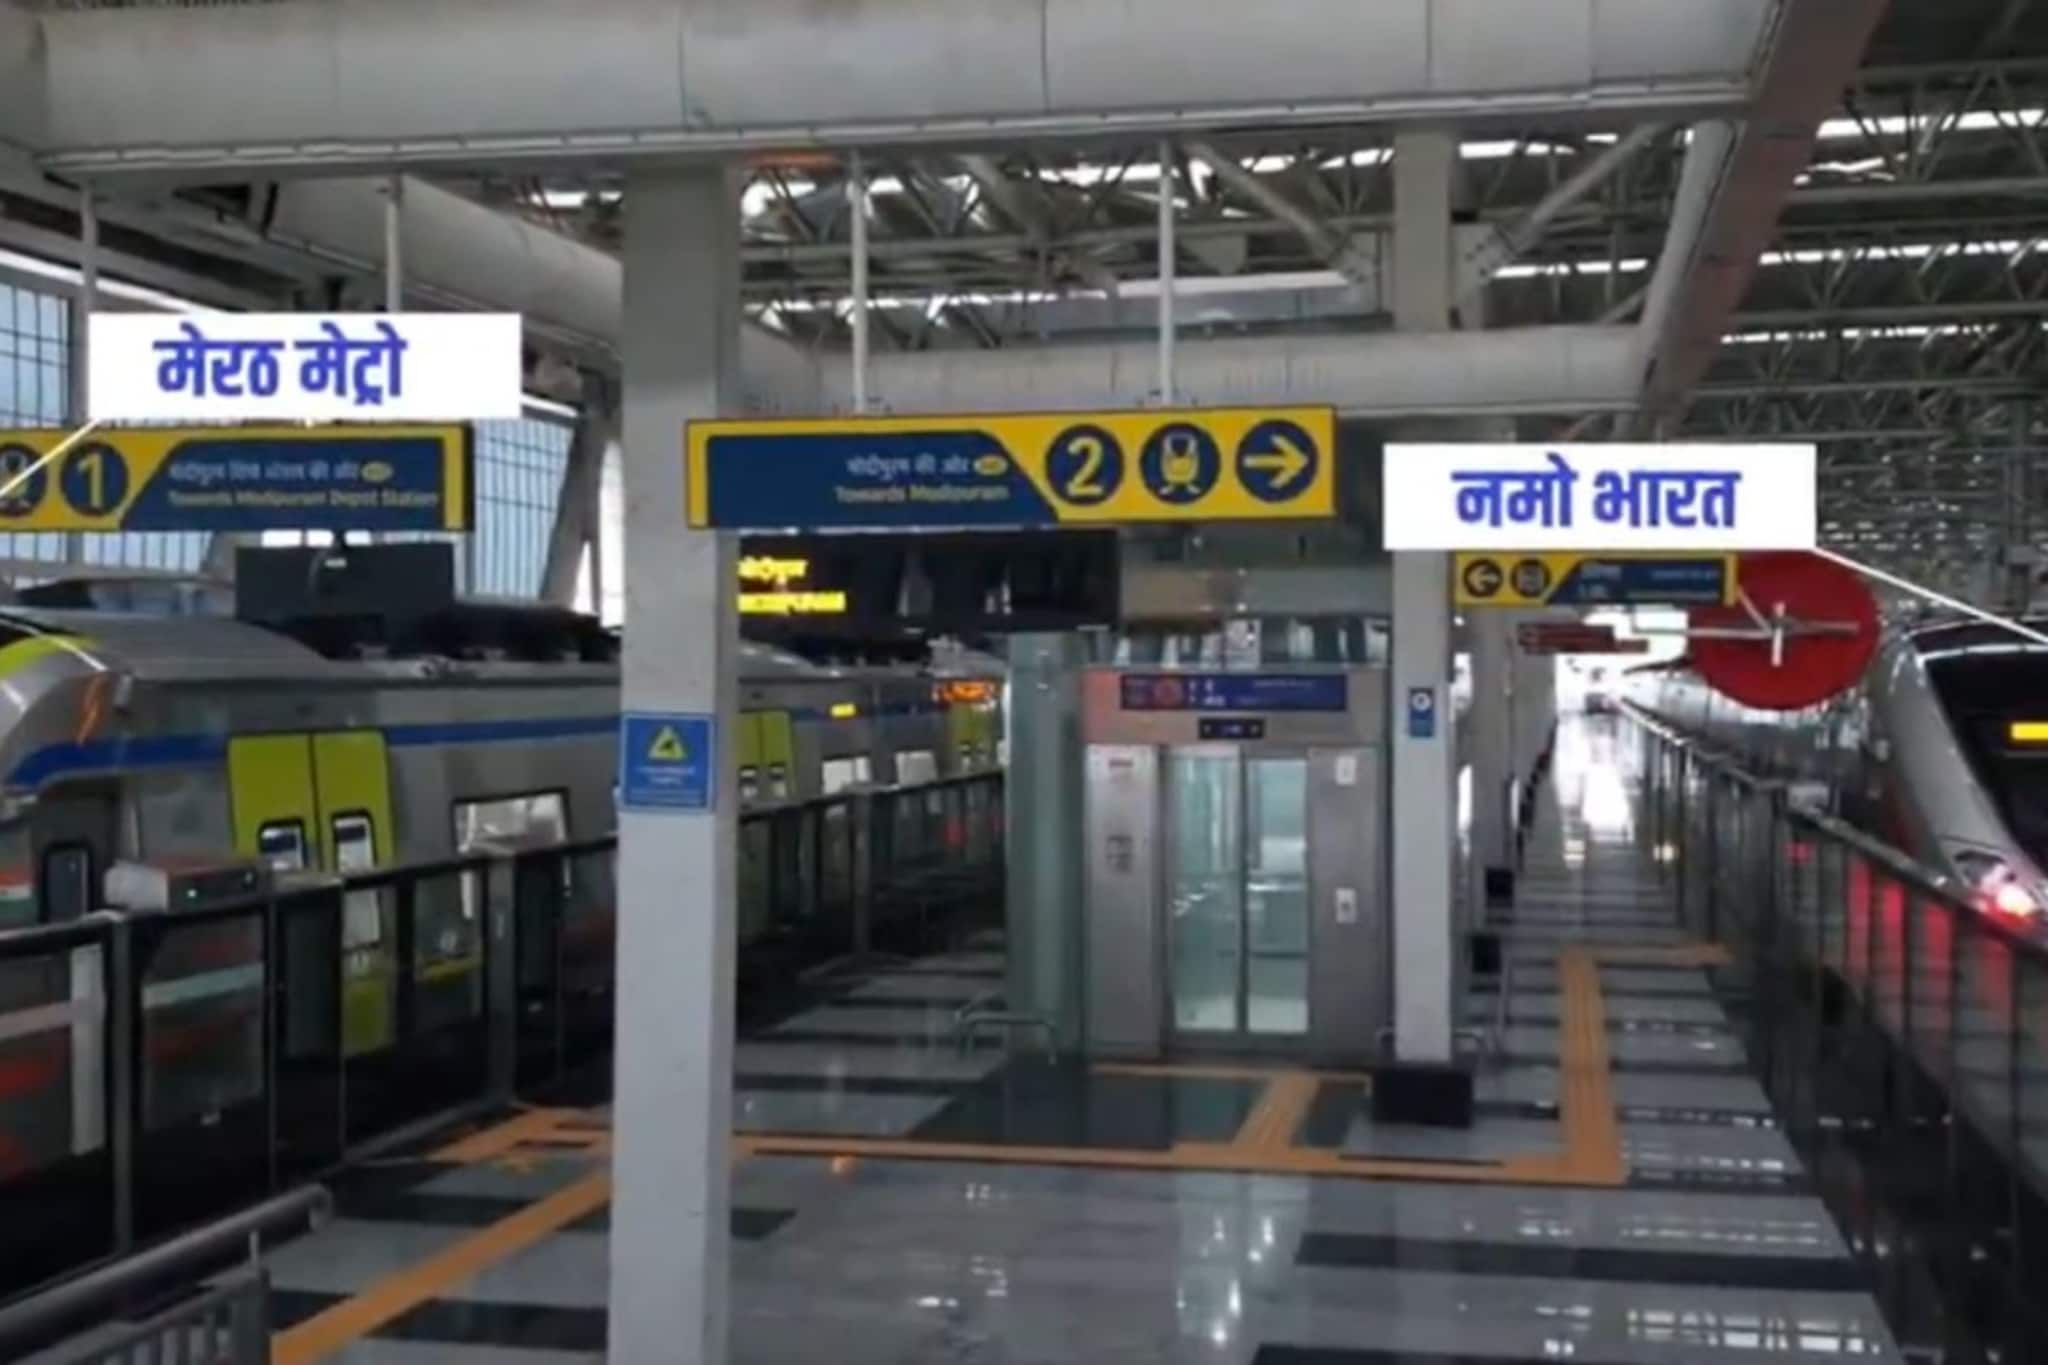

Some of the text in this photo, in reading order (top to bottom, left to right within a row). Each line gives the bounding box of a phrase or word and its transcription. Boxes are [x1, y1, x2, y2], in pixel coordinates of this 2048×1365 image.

[77, 452, 102, 509] 1
[833, 485, 906, 503] Towards
[1066, 436, 1102, 495] 2
